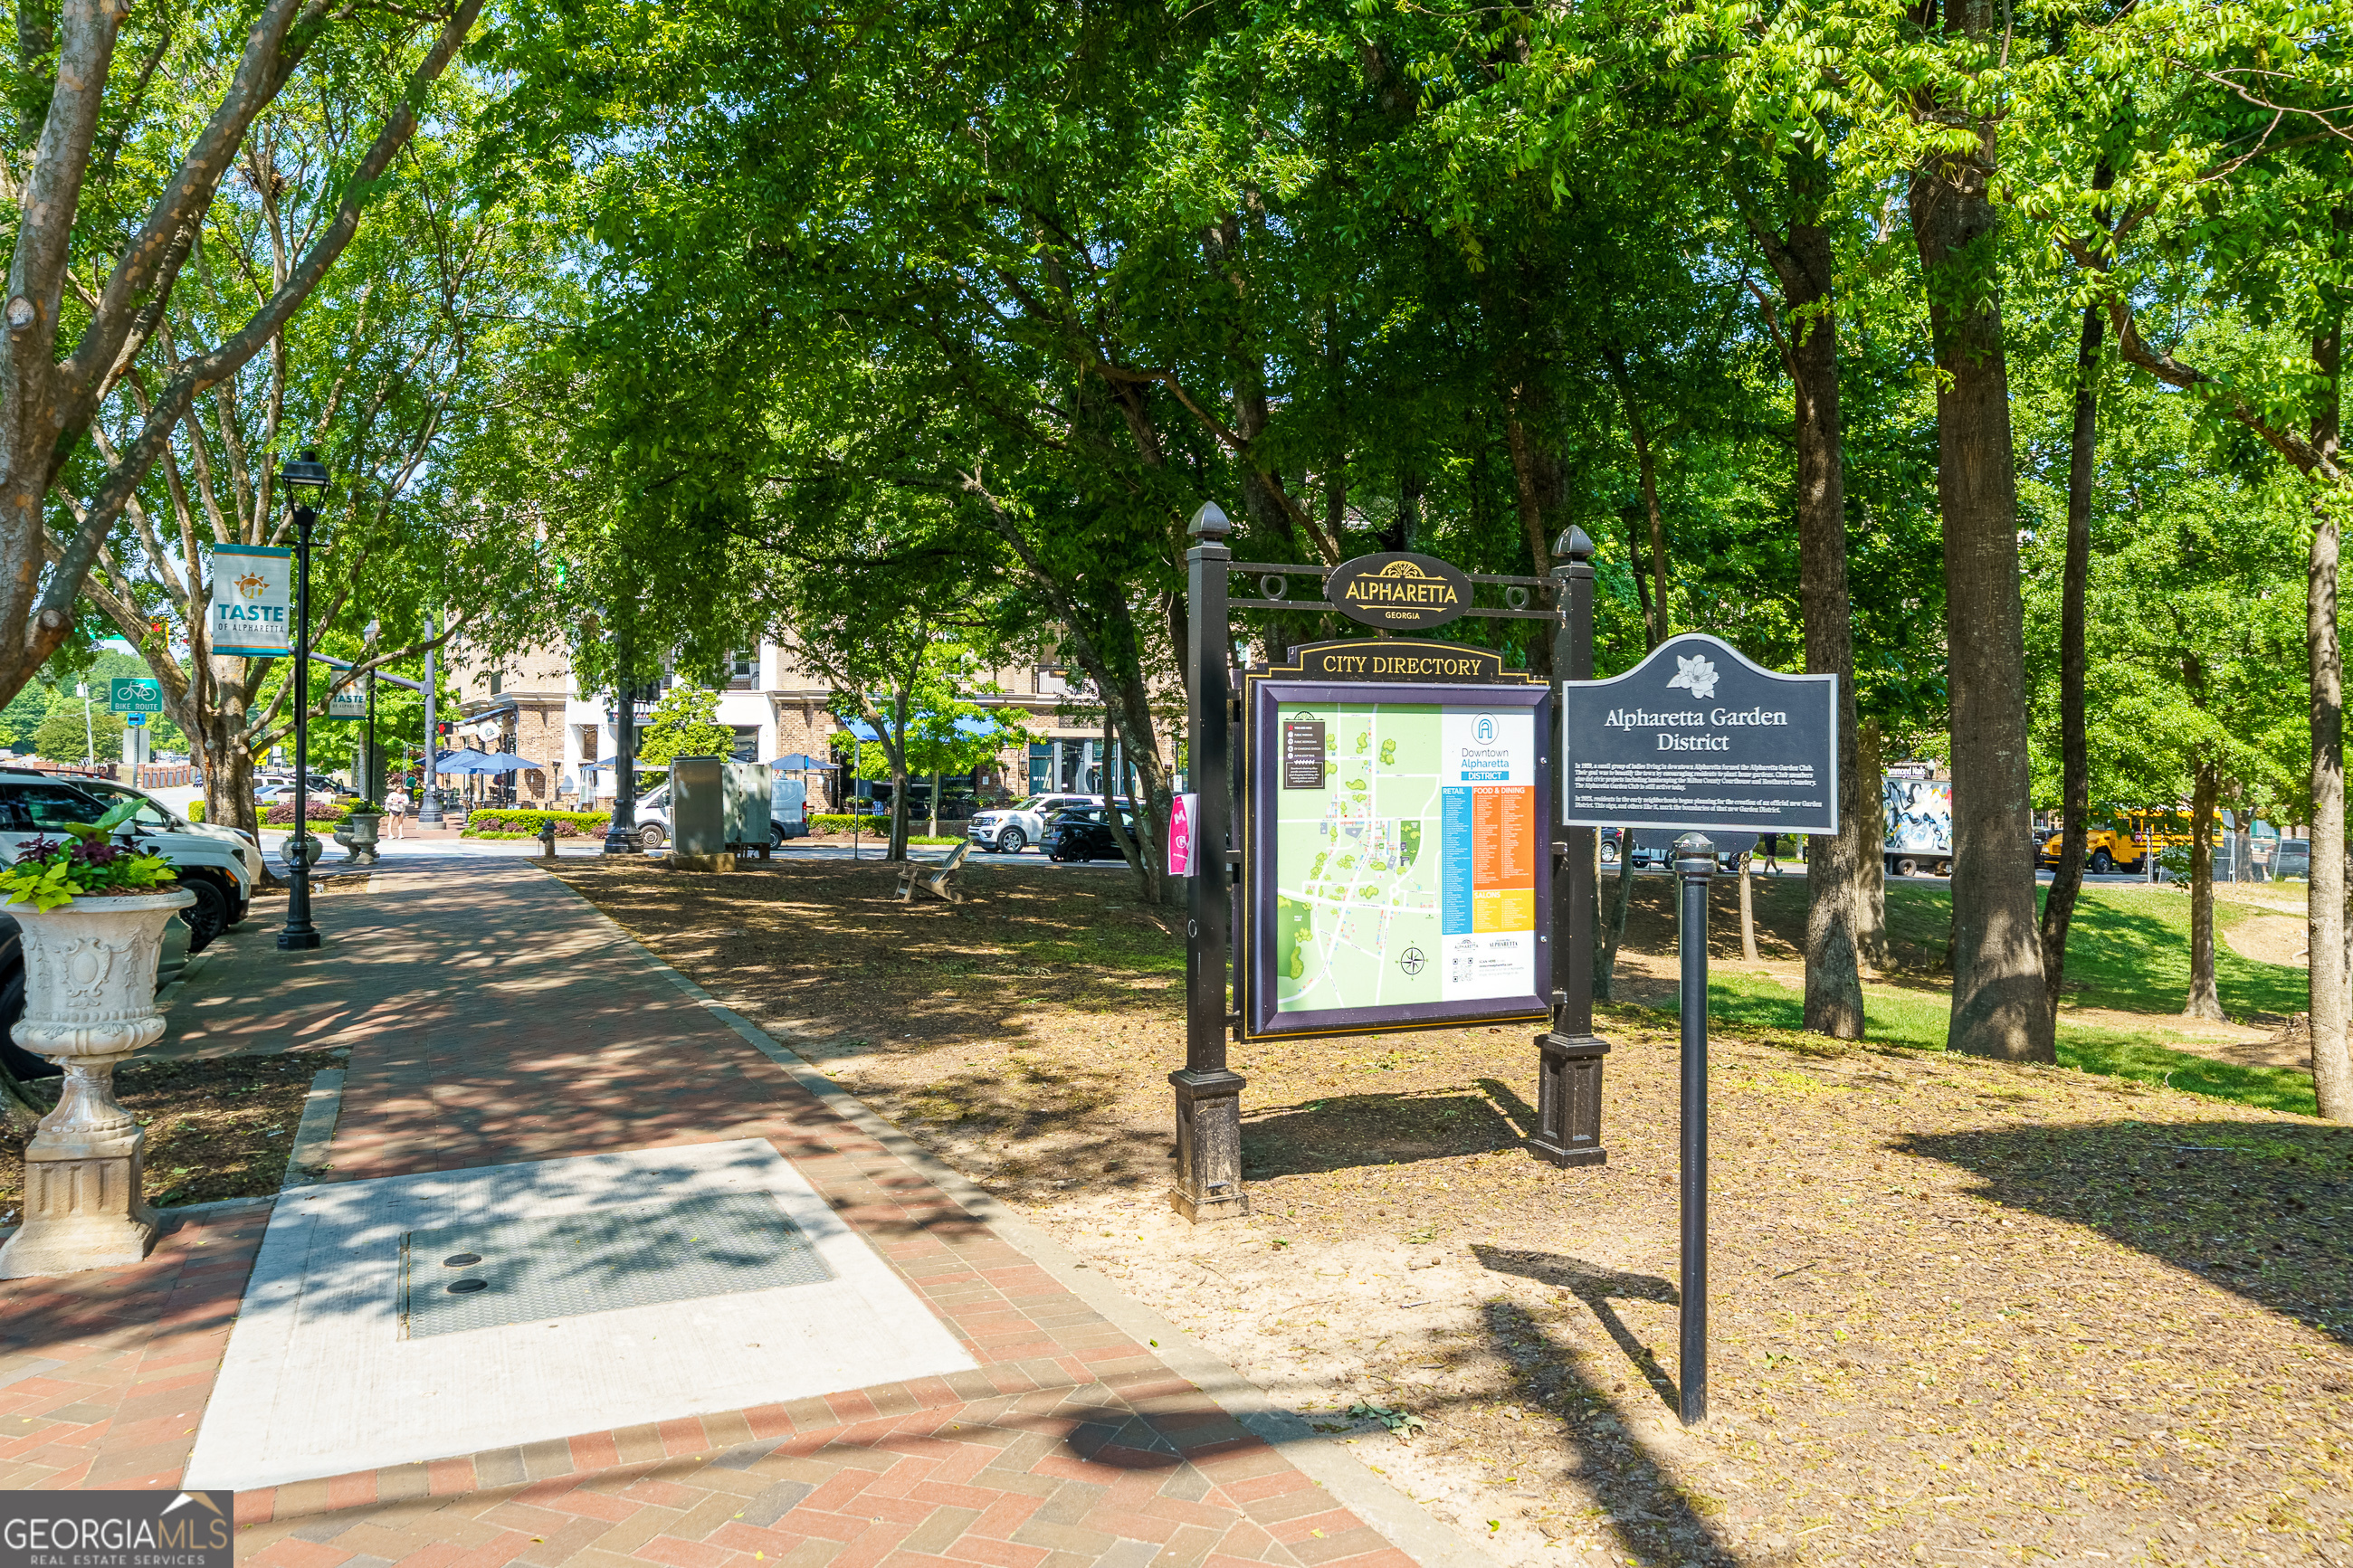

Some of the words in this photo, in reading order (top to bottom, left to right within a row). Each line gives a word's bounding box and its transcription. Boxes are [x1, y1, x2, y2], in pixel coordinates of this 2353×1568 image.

[1345, 581, 1458, 603] ALPHARETTA
[218, 604, 284, 622] TASTE
[1385, 612, 1420, 620] GEORGIA
[233, 624, 284, 632] ALPHARETTA
[1323, 656, 1367, 673] CITY
[1373, 657, 1481, 675] DIRECTORY
[334, 695, 364, 703] TASTE
[1604, 708, 1705, 732] Alpharetta
[1710, 707, 1787, 727] Garden
[1656, 733, 1729, 751] District
[1462, 747, 1509, 757] Downtown
[1461, 759, 1509, 770] Alpharetta
[1468, 772, 1502, 780] DISTRICT
